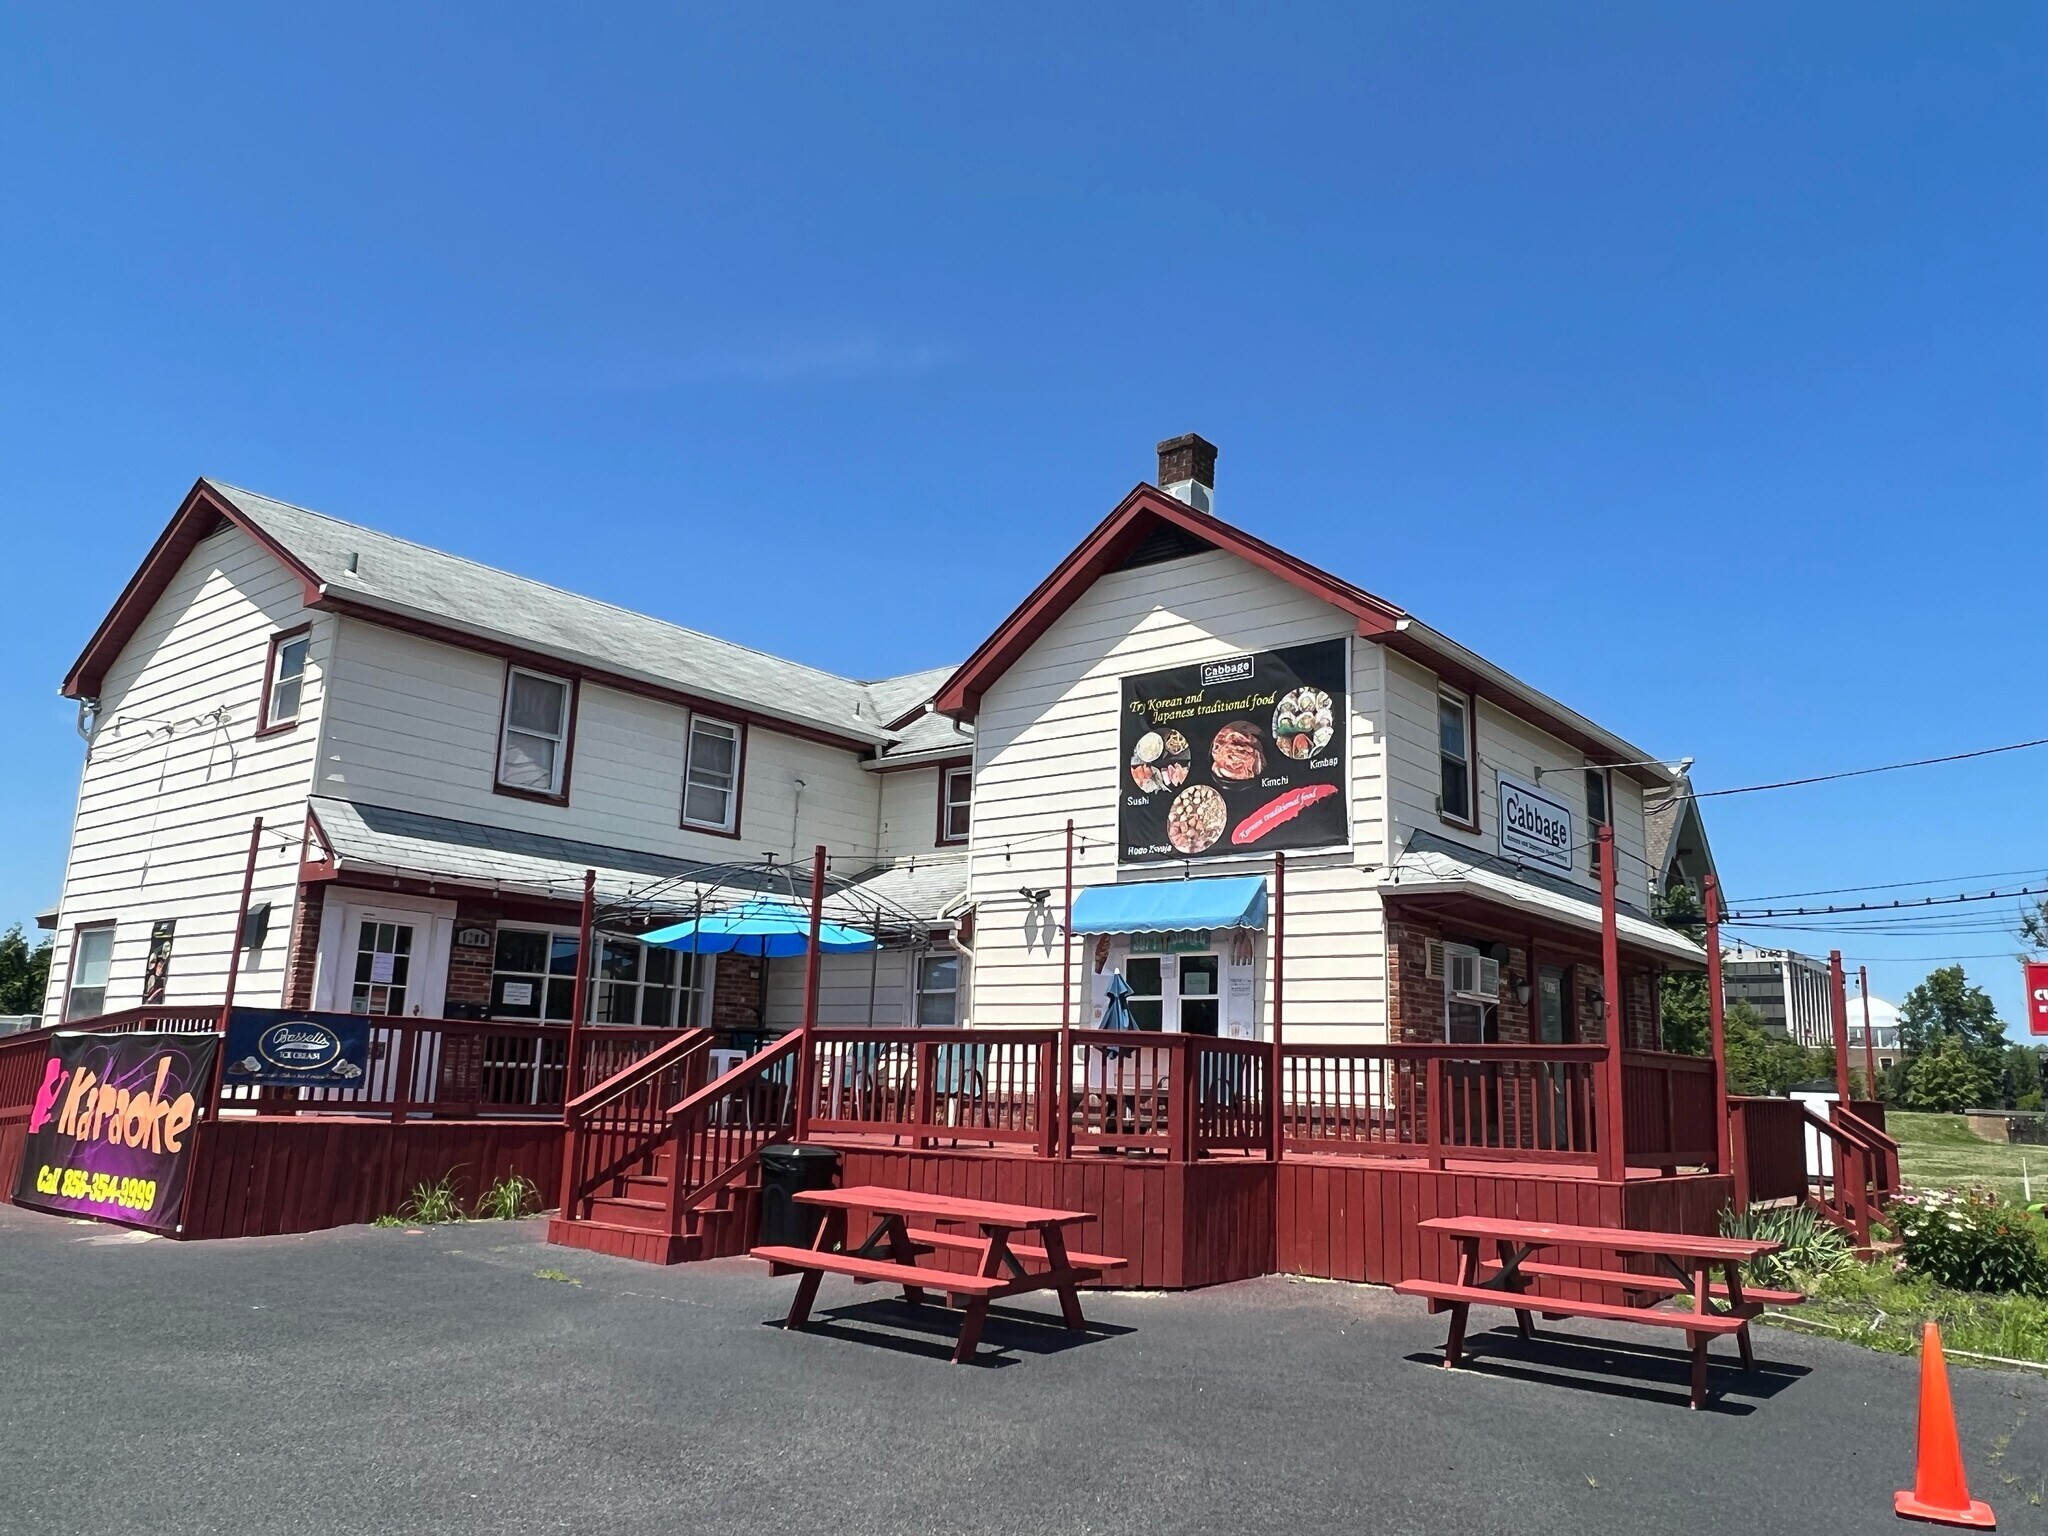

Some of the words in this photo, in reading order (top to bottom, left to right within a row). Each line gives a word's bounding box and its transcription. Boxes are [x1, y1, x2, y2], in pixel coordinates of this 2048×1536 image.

[1205, 662, 1249, 677] Cabbage
[1130, 701, 1146, 715] Try
[1147, 697, 1182, 711] Korean
[1184, 690, 1205, 704] and
[1152, 707, 1194, 724] Japanese
[1197, 695, 1251, 714] traditional
[1249, 691, 1277, 711] food
[1310, 757, 1338, 769] Kimbap
[1261, 775, 1289, 787] Kimchi
[1127, 796, 1149, 806] Sushi
[1506, 793, 1567, 847] Cabbage
[280, 1051, 292, 1059] ICE
[293, 1051, 321, 1060] CREAM
[58, 1056, 195, 1154] Karaoke
[37, 1165, 62, 1194] Call
